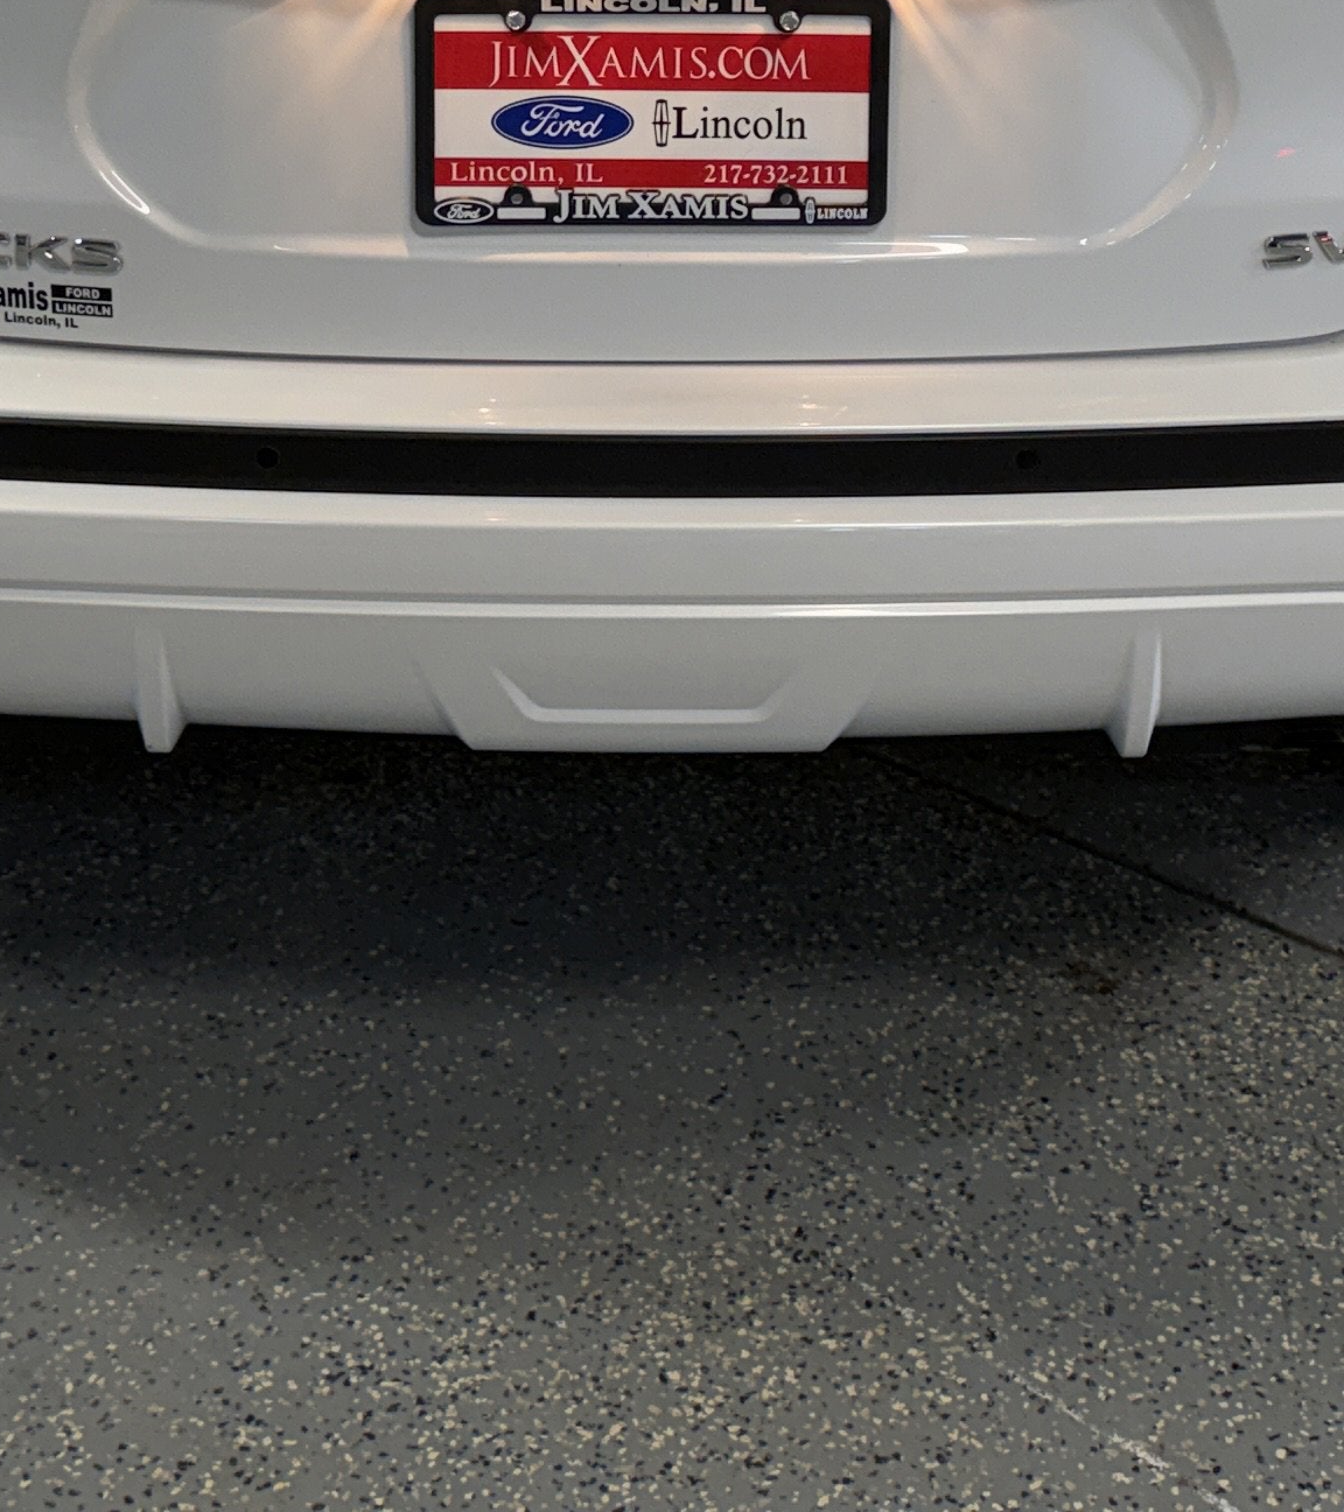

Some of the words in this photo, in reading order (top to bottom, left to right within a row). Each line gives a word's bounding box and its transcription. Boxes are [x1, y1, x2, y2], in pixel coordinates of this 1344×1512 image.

[520, 102, 604, 140] Ford
[672, 107, 807, 140] Lincoln
[450, 162, 563, 187] Lincoln,
[575, 164, 604, 184] IL
[703, 164, 847, 185] 217-732-2111
[446, 203, 482, 220] Ford
[553, 188, 620, 224] JIM
[627, 189, 749, 220] XAMIS
[816, 207, 868, 220] LINCOLN
[65, 287, 101, 300] FORD
[55, 300, 112, 317] LINCOLN
[4, 311, 62, 329] Lincoln,
[64, 316, 79, 329] IL
